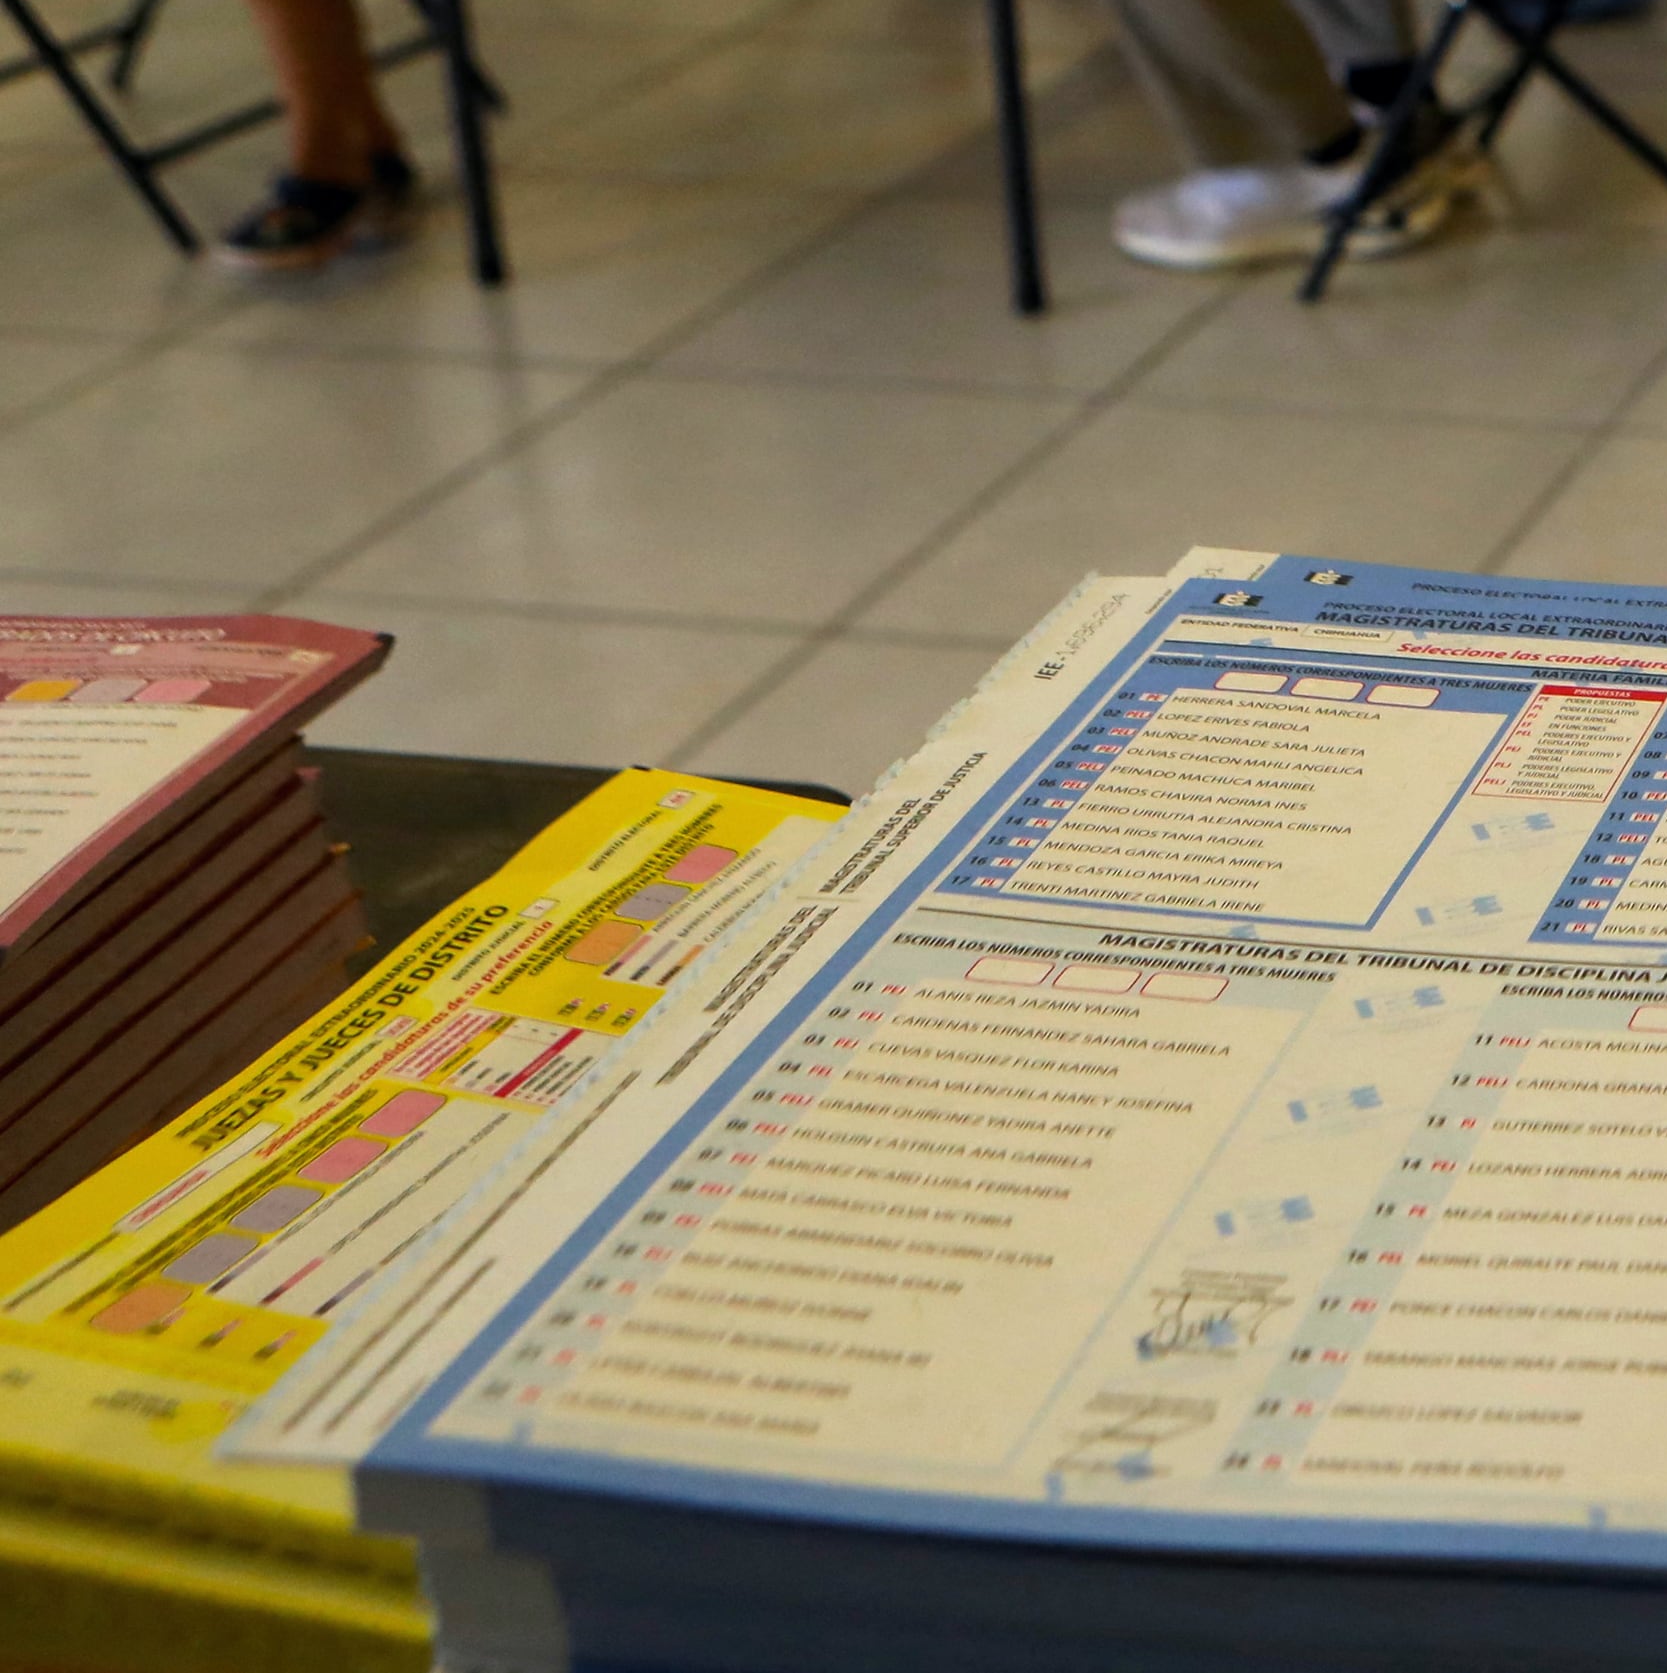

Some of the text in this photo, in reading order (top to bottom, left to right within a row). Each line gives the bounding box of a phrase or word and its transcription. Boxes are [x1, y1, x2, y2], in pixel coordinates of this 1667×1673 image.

[1323, 600, 1396, 614] PROCESO
[1398, 604, 1484, 619] ELECTORAL
[1488, 610, 1537, 622] LOCAL
[1179, 618, 1300, 632] ENTIDAD FEDERATIVA
[1313, 628, 1381, 640] CHIHUAHUA
[1315, 612, 1511, 633] MAGISTRATURAS
[1516, 623, 1561, 637] DEL
[1397, 642, 1507, 660] Seleccione
[1512, 650, 1540, 662] las
[1147, 656, 1534, 693] ESCRIBA LOS NÚMEROS CORRESPONDIENTES A TRES MUJERES
[1530, 670, 1609, 681] MATERIA
[838, 752, 988, 894] TRIBUNAL SUPERIOR DE JUSTICIA
[818, 798, 922, 894] MAGISTRATURAS DEL
[1097, 933, 1300, 961] MAGISTRATURAS
[1304, 949, 1351, 965] DEL
[1357, 953, 1476, 974] TRIBUNAL
[1479, 961, 1514, 976] DE
[1517, 964, 1653, 983] DISCIPLINA
[192, 904, 509, 1152] JUEZAS Y JUECES DE DISTRITO
